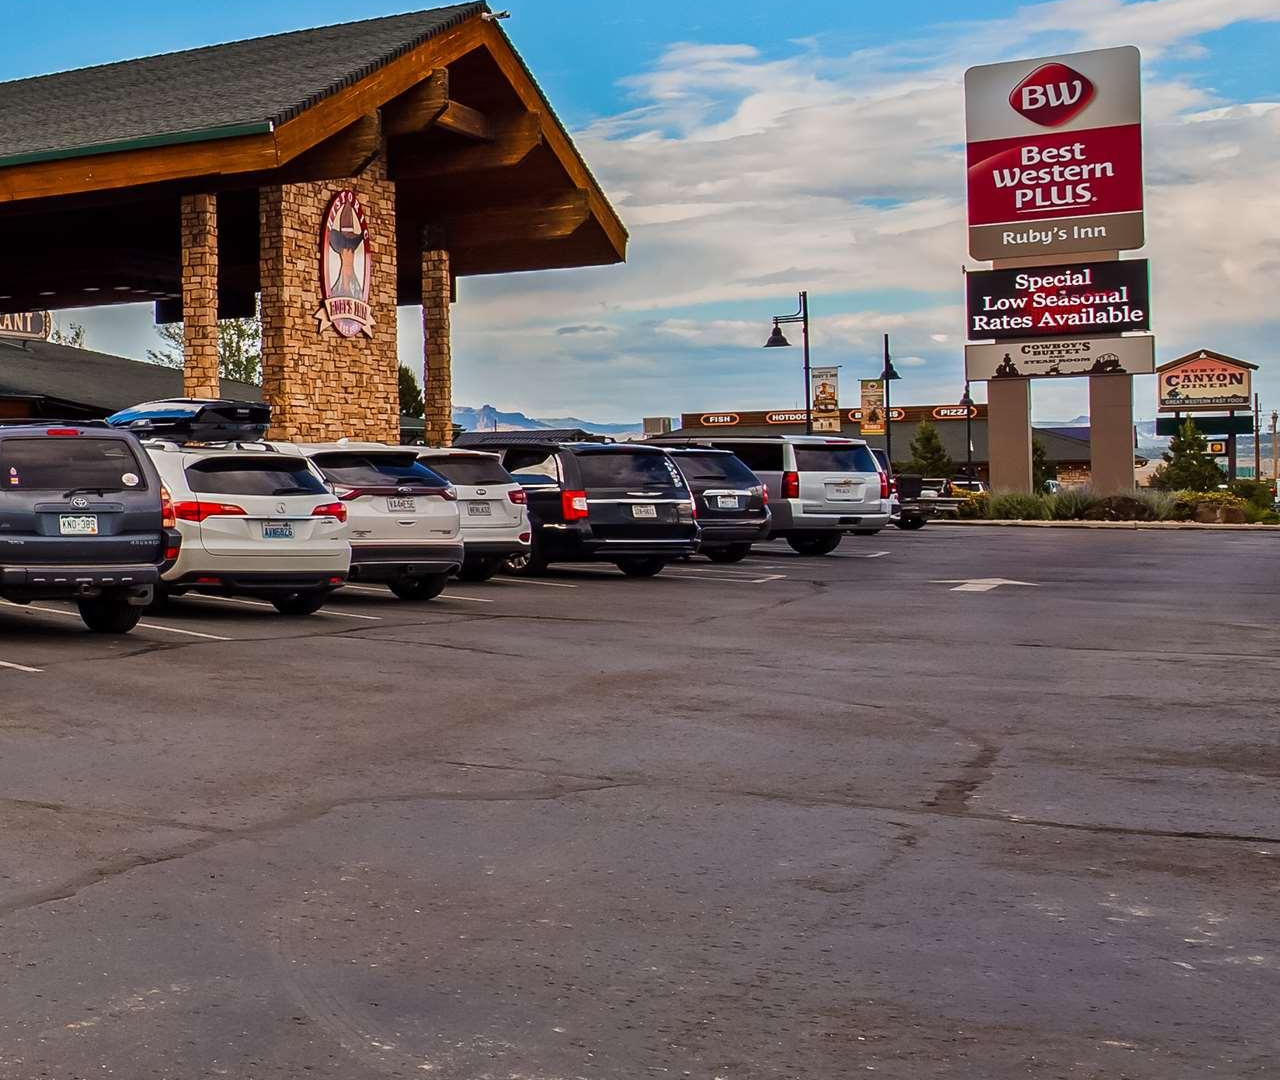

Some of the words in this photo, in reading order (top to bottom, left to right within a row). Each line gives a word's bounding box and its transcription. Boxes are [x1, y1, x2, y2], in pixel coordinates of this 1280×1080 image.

[1021, 80, 1083, 110] BW
[1021, 142, 1086, 166] Best
[993, 160, 1114, 188] Western
[1002, 227, 1067, 245] Ruby's
[1073, 225, 1107, 239] Inn
[1015, 269, 1091, 292] Special
[983, 296, 1028, 311] Low
[1033, 287, 1128, 308] Seasonal
[973, 315, 1033, 331] Rates
[1037, 306, 1143, 327] Available
[1021, 342, 1091, 354] COWBOY'S
[1165, 373, 1245, 387] CANYON
